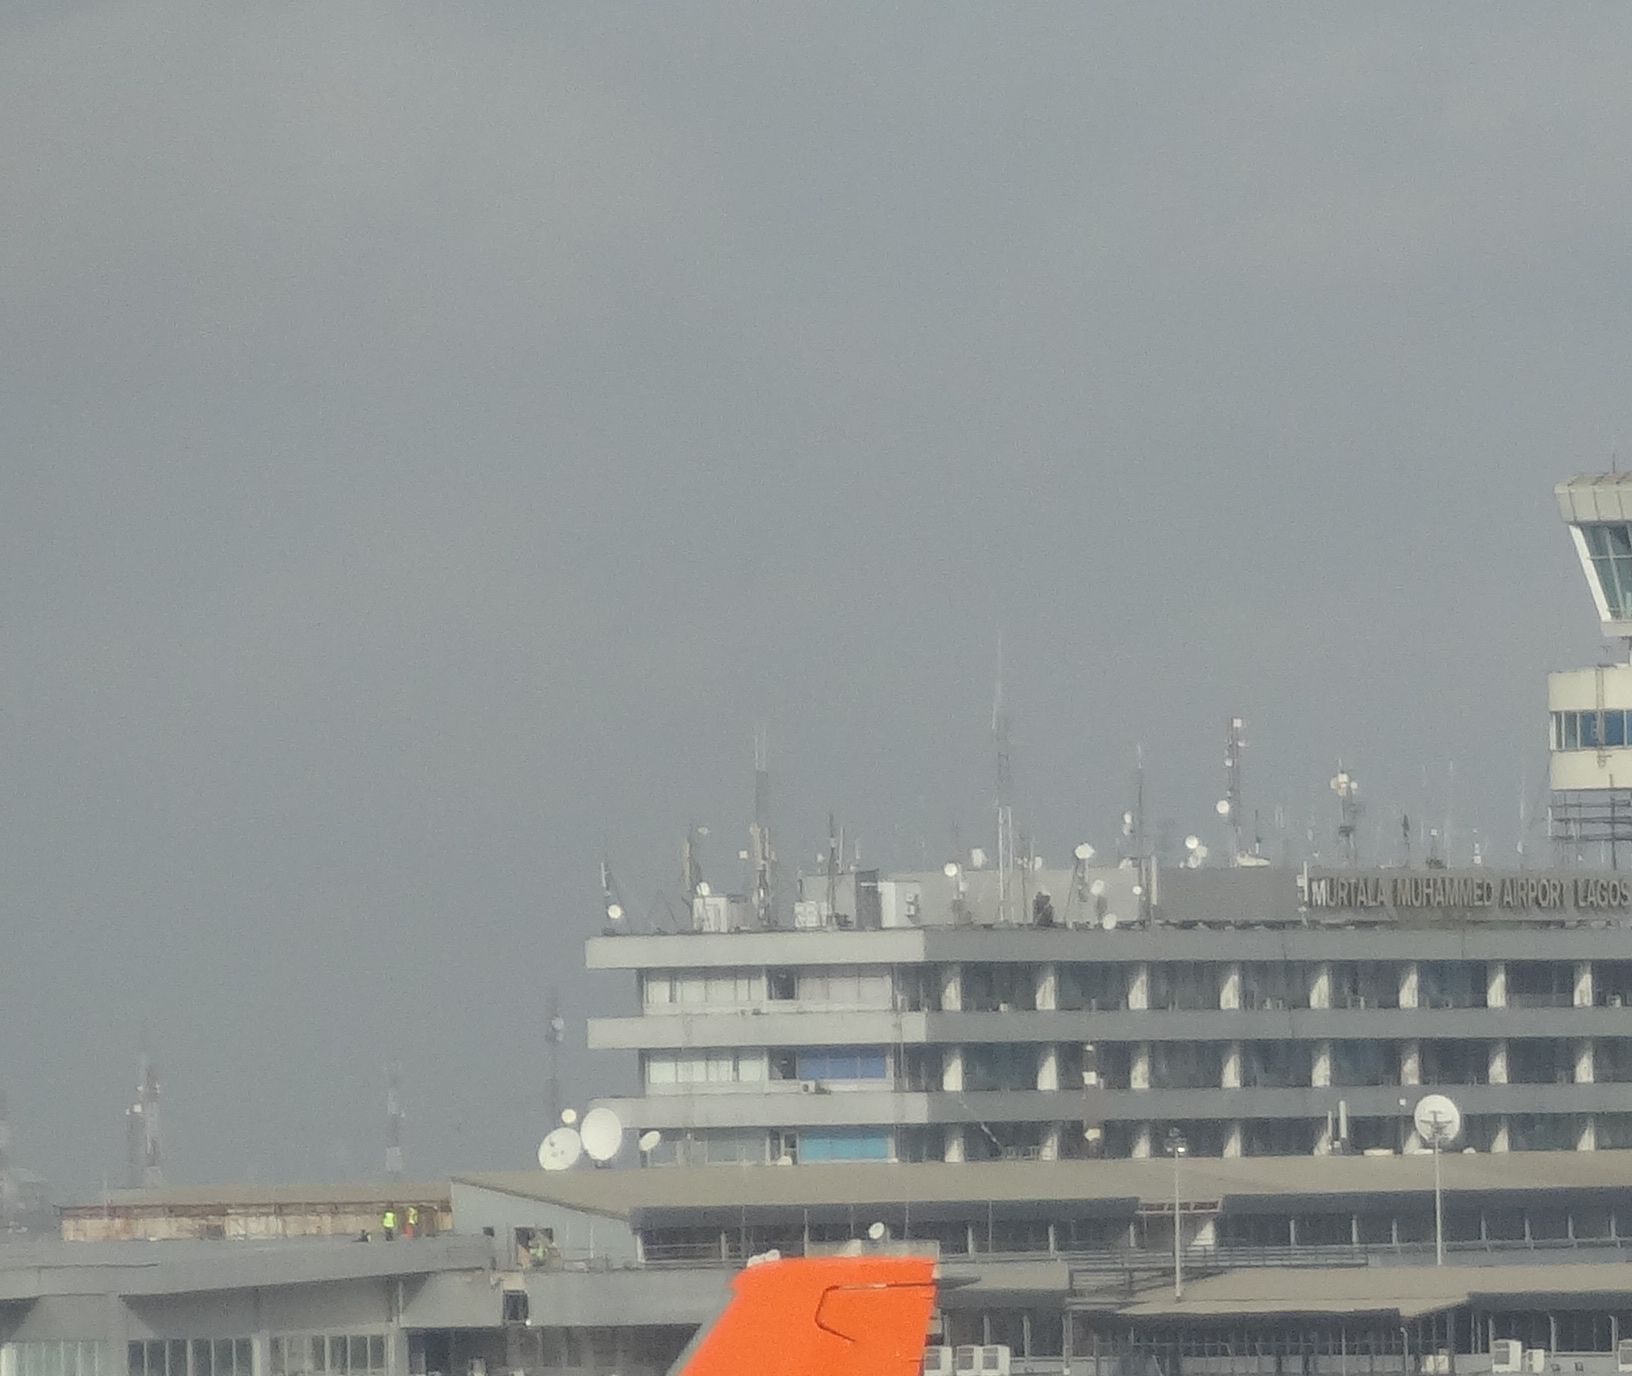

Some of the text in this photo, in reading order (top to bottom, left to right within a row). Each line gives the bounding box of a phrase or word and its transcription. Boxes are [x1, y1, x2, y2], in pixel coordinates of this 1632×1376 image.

[1309, 878, 1386, 907] MURTALA
[1396, 877, 1494, 908] MUHAMMED
[1574, 878, 1630, 907] LAGOS
